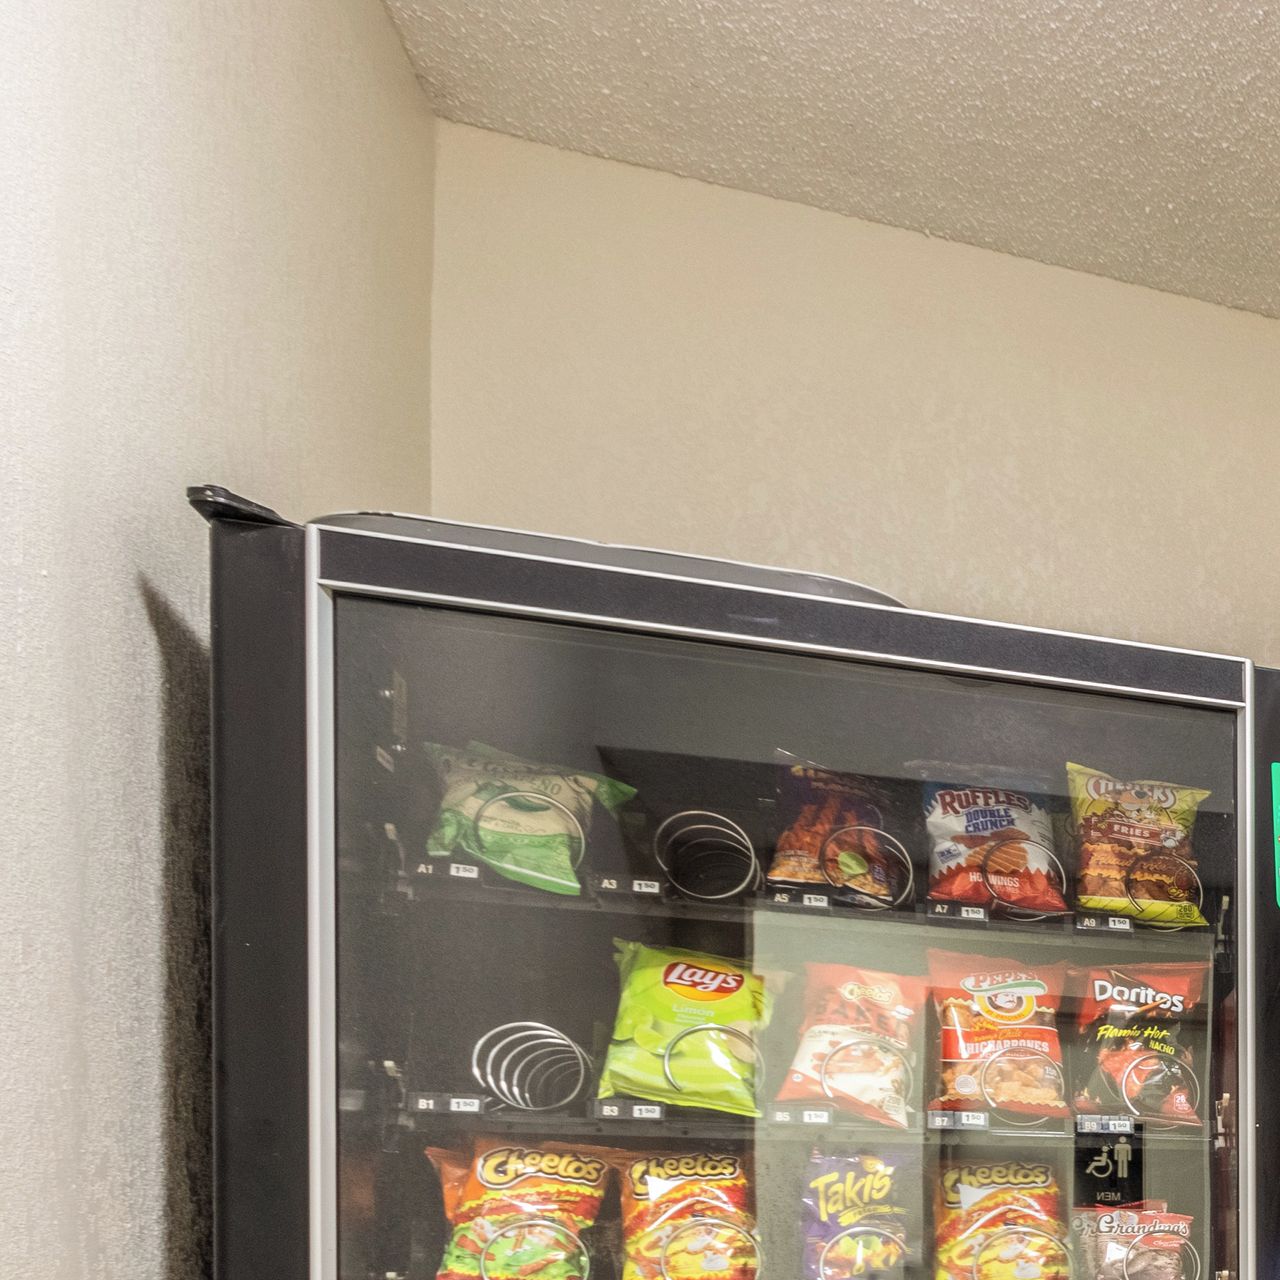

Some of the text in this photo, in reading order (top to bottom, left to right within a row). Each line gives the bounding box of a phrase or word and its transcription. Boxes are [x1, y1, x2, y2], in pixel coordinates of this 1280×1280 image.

[937, 789, 1030, 815] RUFFLES
[965, 808, 1012, 823] DOUBLE
[964, 817, 1015, 834] CRUNCH
[1113, 824, 1150, 837] FRIES
[418, 863, 433, 874] A1
[602, 879, 617, 889] A3
[989, 876, 1020, 888] WINGS
[775, 893, 789, 903] A5
[935, 904, 948, 914] A7
[1083, 918, 1096, 927] A9
[666, 963, 744, 992] Lay's
[1094, 979, 1184, 1013] Doritos
[1149, 1041, 1175, 1055] NACHO
[418, 1099, 434, 1109] B1
[602, 1106, 618, 1116] B3
[776, 1112, 790, 1121] B5
[935, 1117, 948, 1126] B7
[1085, 1121, 1097, 1130] B9
[482, 1149, 603, 1184] Cheetos
[631, 1154, 738, 1197] Cheetos
[944, 1163, 1049, 1207] Cheetos
[809, 1166, 893, 1221] Takis
[1097, 1214, 1190, 1236] Grandma's
